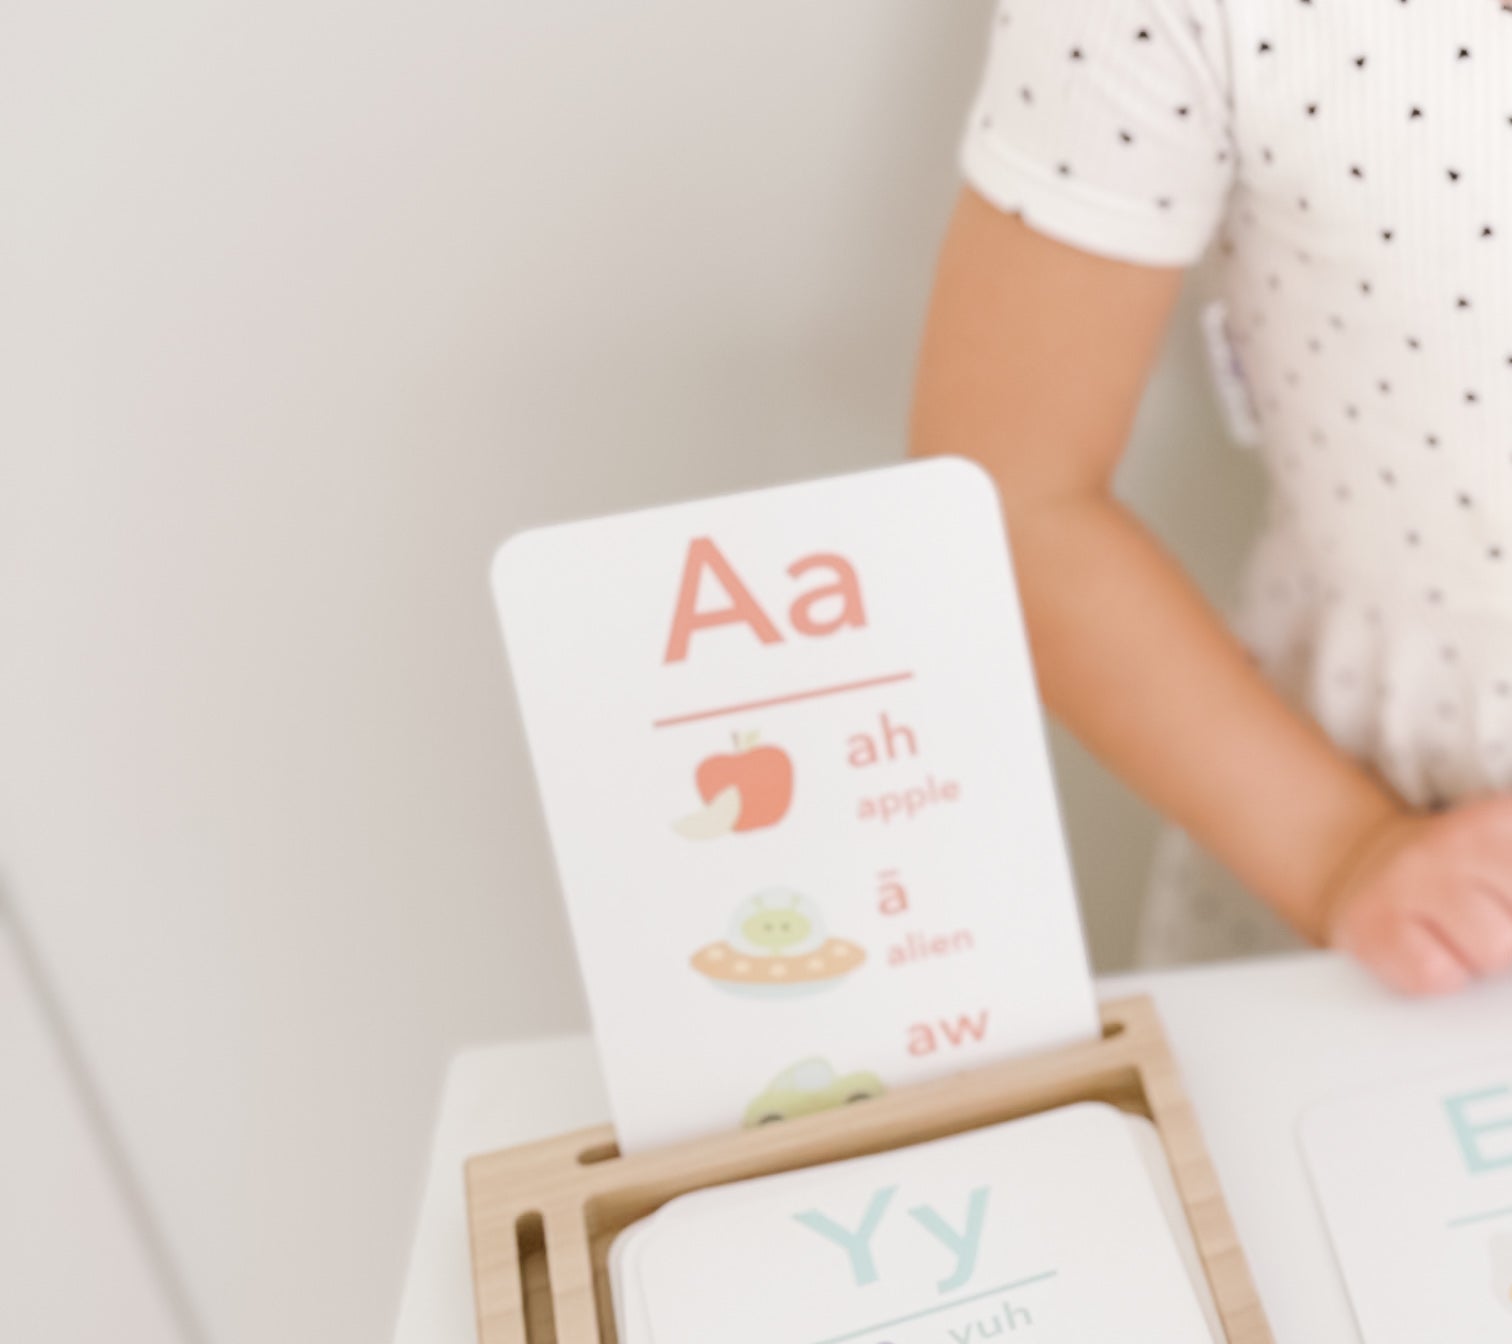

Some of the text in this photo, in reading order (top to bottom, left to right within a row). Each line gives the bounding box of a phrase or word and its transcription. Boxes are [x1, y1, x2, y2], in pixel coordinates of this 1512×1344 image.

[663, 536, 868, 665] Aa
[847, 711, 918, 769] ah
[856, 772, 963, 826] apple
[886, 929, 975, 967] alien
[906, 1010, 988, 1058] aw
[792, 1185, 992, 1295] Yy
